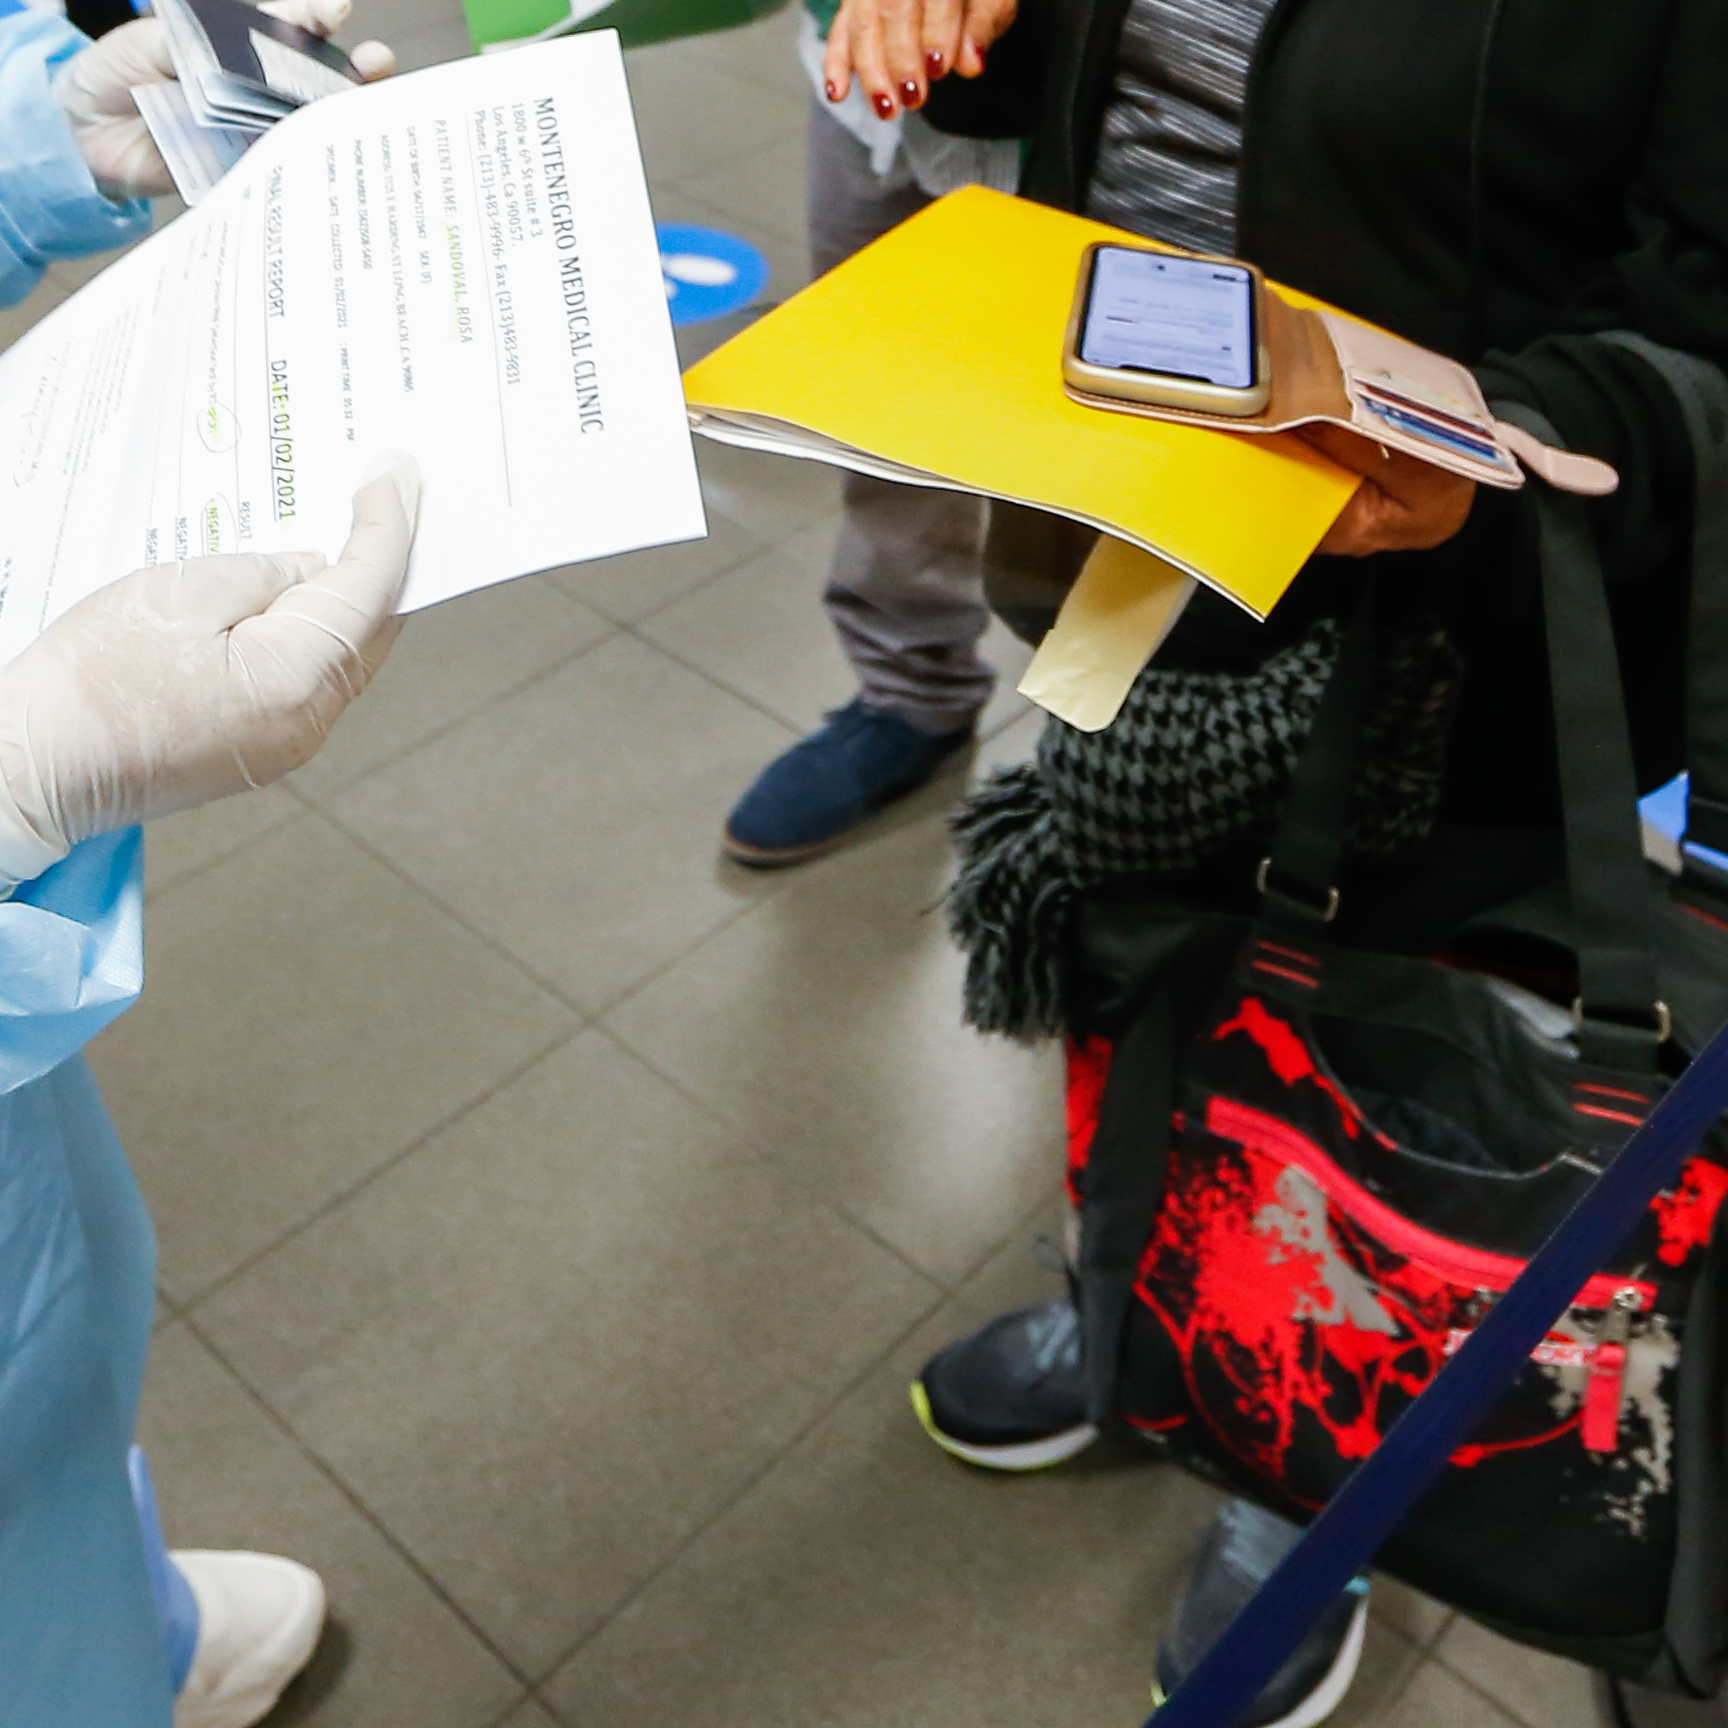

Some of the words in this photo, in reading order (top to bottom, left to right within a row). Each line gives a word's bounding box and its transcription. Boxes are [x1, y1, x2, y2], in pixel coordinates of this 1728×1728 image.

[492, 106, 504, 127] Los
[512, 103, 527, 132] 1800
[435, 120, 452, 172] PATIENT
[495, 130, 512, 180] Angeles,
[442, 177, 457, 217] NAME:
[503, 183, 516, 198] Ca
[521, 168, 534, 180] St
[535, 97, 576, 250] MONTENEGRO
[474, 110, 487, 151] Phone:
[494, 264, 507, 287] Fax
[523, 183, 537, 214] suite
[506, 200, 524, 246] 90057.
[530, 229, 543, 237] 3
[446, 225, 467, 303] SANDOVAL,
[268, 259, 285, 317] REPORT
[559, 256, 592, 356] MEDICAL
[456, 306, 473, 343] ROSA
[271, 360, 289, 409] DATE:
[573, 360, 604, 433] CLINIC
[269, 413, 296, 519] 01/02/2021
[205, 506, 219, 556] NEGATIV
[240, 501, 252, 539] RESULT
[146, 528, 158, 568] NEGATI
